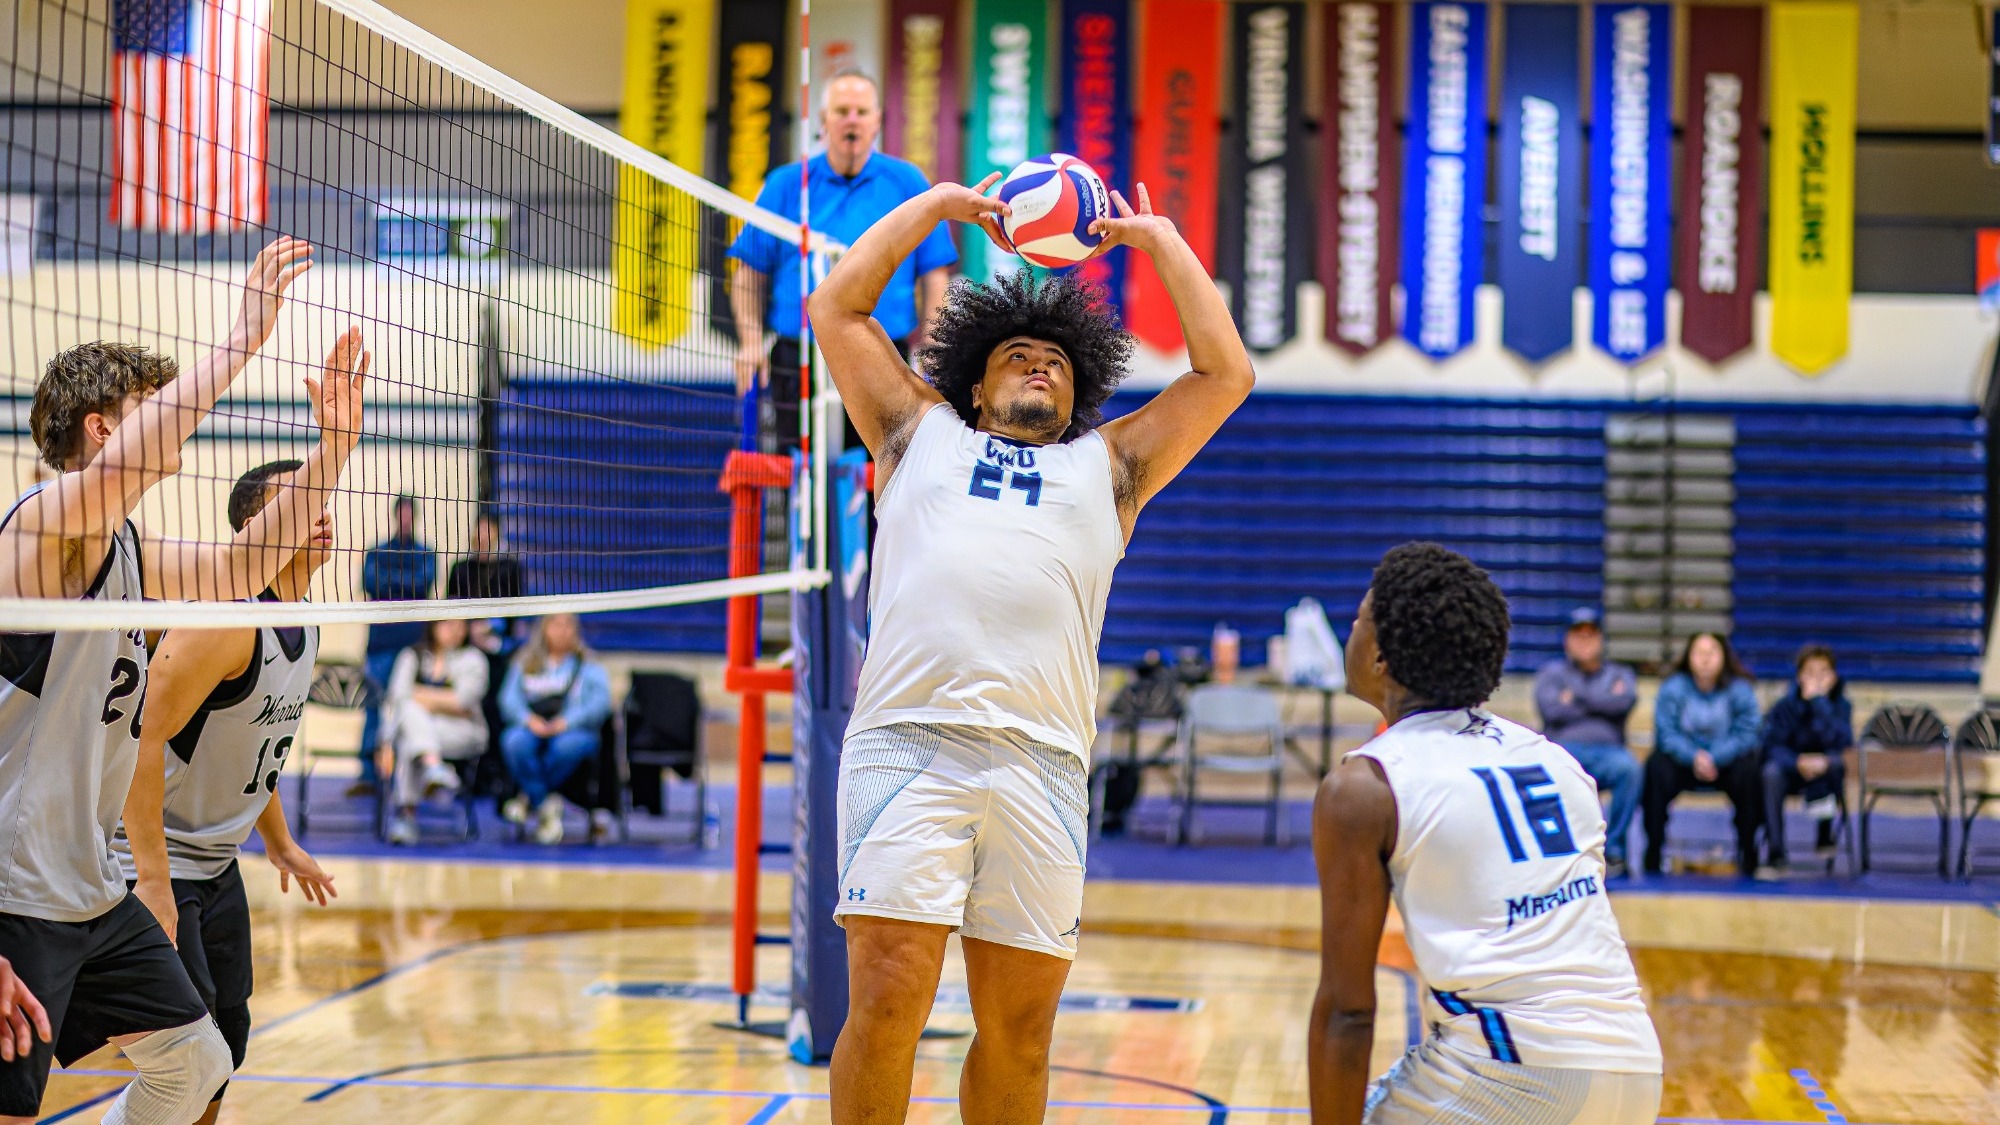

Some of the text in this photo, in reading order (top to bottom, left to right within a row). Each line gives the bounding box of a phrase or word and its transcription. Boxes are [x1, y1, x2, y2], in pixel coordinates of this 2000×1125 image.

[987, 24, 1033, 166] SWEET
[1428, 4, 1470, 152] EASTERN
[1610, 7, 1651, 248] WASHINGTON
[1244, 6, 1289, 349] VIRGINIA WESLEYAN
[1519, 94, 1559, 261] AVERETT
[1700, 72, 1742, 294] ROANOKE
[1798, 103, 1830, 264] HOLLINS
[1608, 288, 1648, 355] LEE
[968, 458, 1043, 507] 27
[248, 694, 304, 727] Warrio
[1468, 763, 1581, 863] 16
